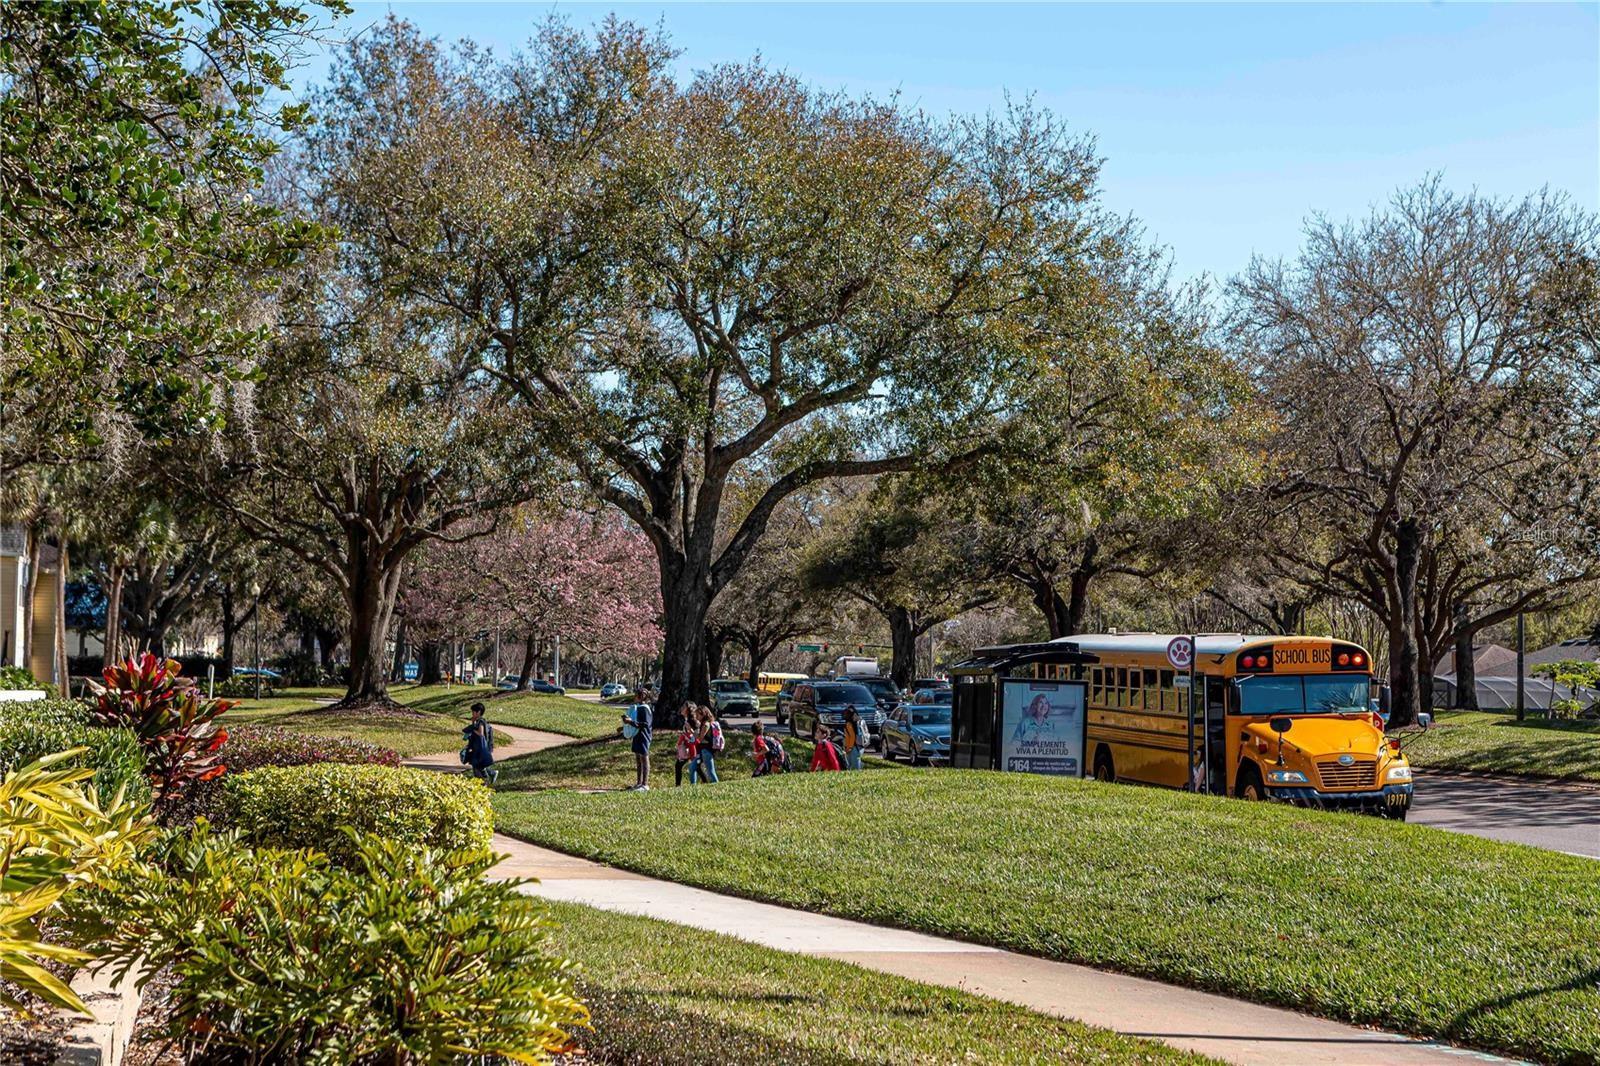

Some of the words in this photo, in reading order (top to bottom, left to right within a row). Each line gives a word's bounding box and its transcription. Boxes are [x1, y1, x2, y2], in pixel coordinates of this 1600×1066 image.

[1274, 649, 1310, 665] SCHOOL
[1312, 648, 1331, 664] BUS
[1020, 740, 1067, 748] SIMPLEMENTE
[1015, 747, 1031, 755] VIVA
[1038, 748, 1069, 756] PLENITUD
[1009, 760, 1030, 772] $164
[1387, 793, 1407, 806] 19171
